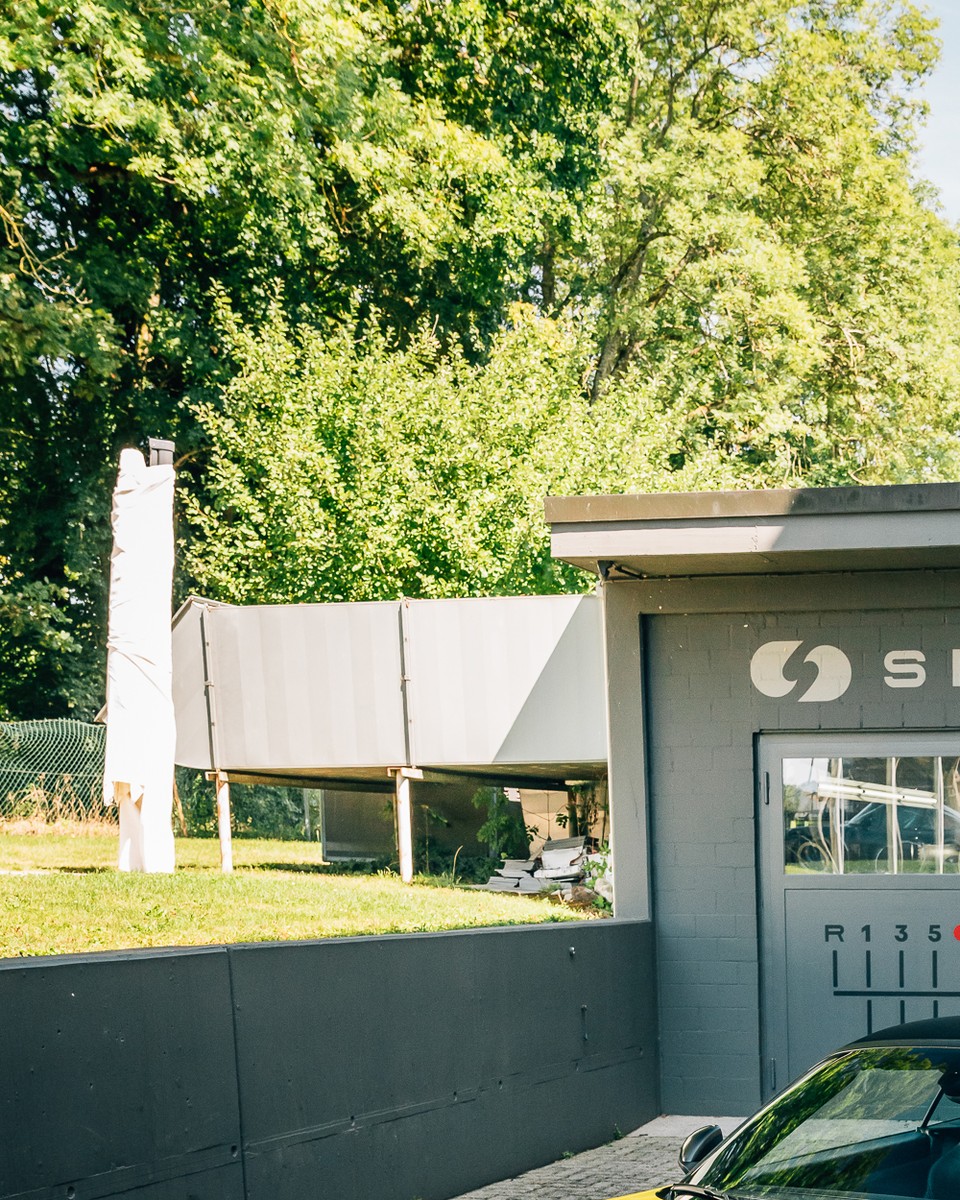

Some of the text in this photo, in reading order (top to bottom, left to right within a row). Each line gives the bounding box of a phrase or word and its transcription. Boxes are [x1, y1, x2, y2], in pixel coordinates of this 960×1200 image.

[824, 924, 942, 943] R 1 3 5
